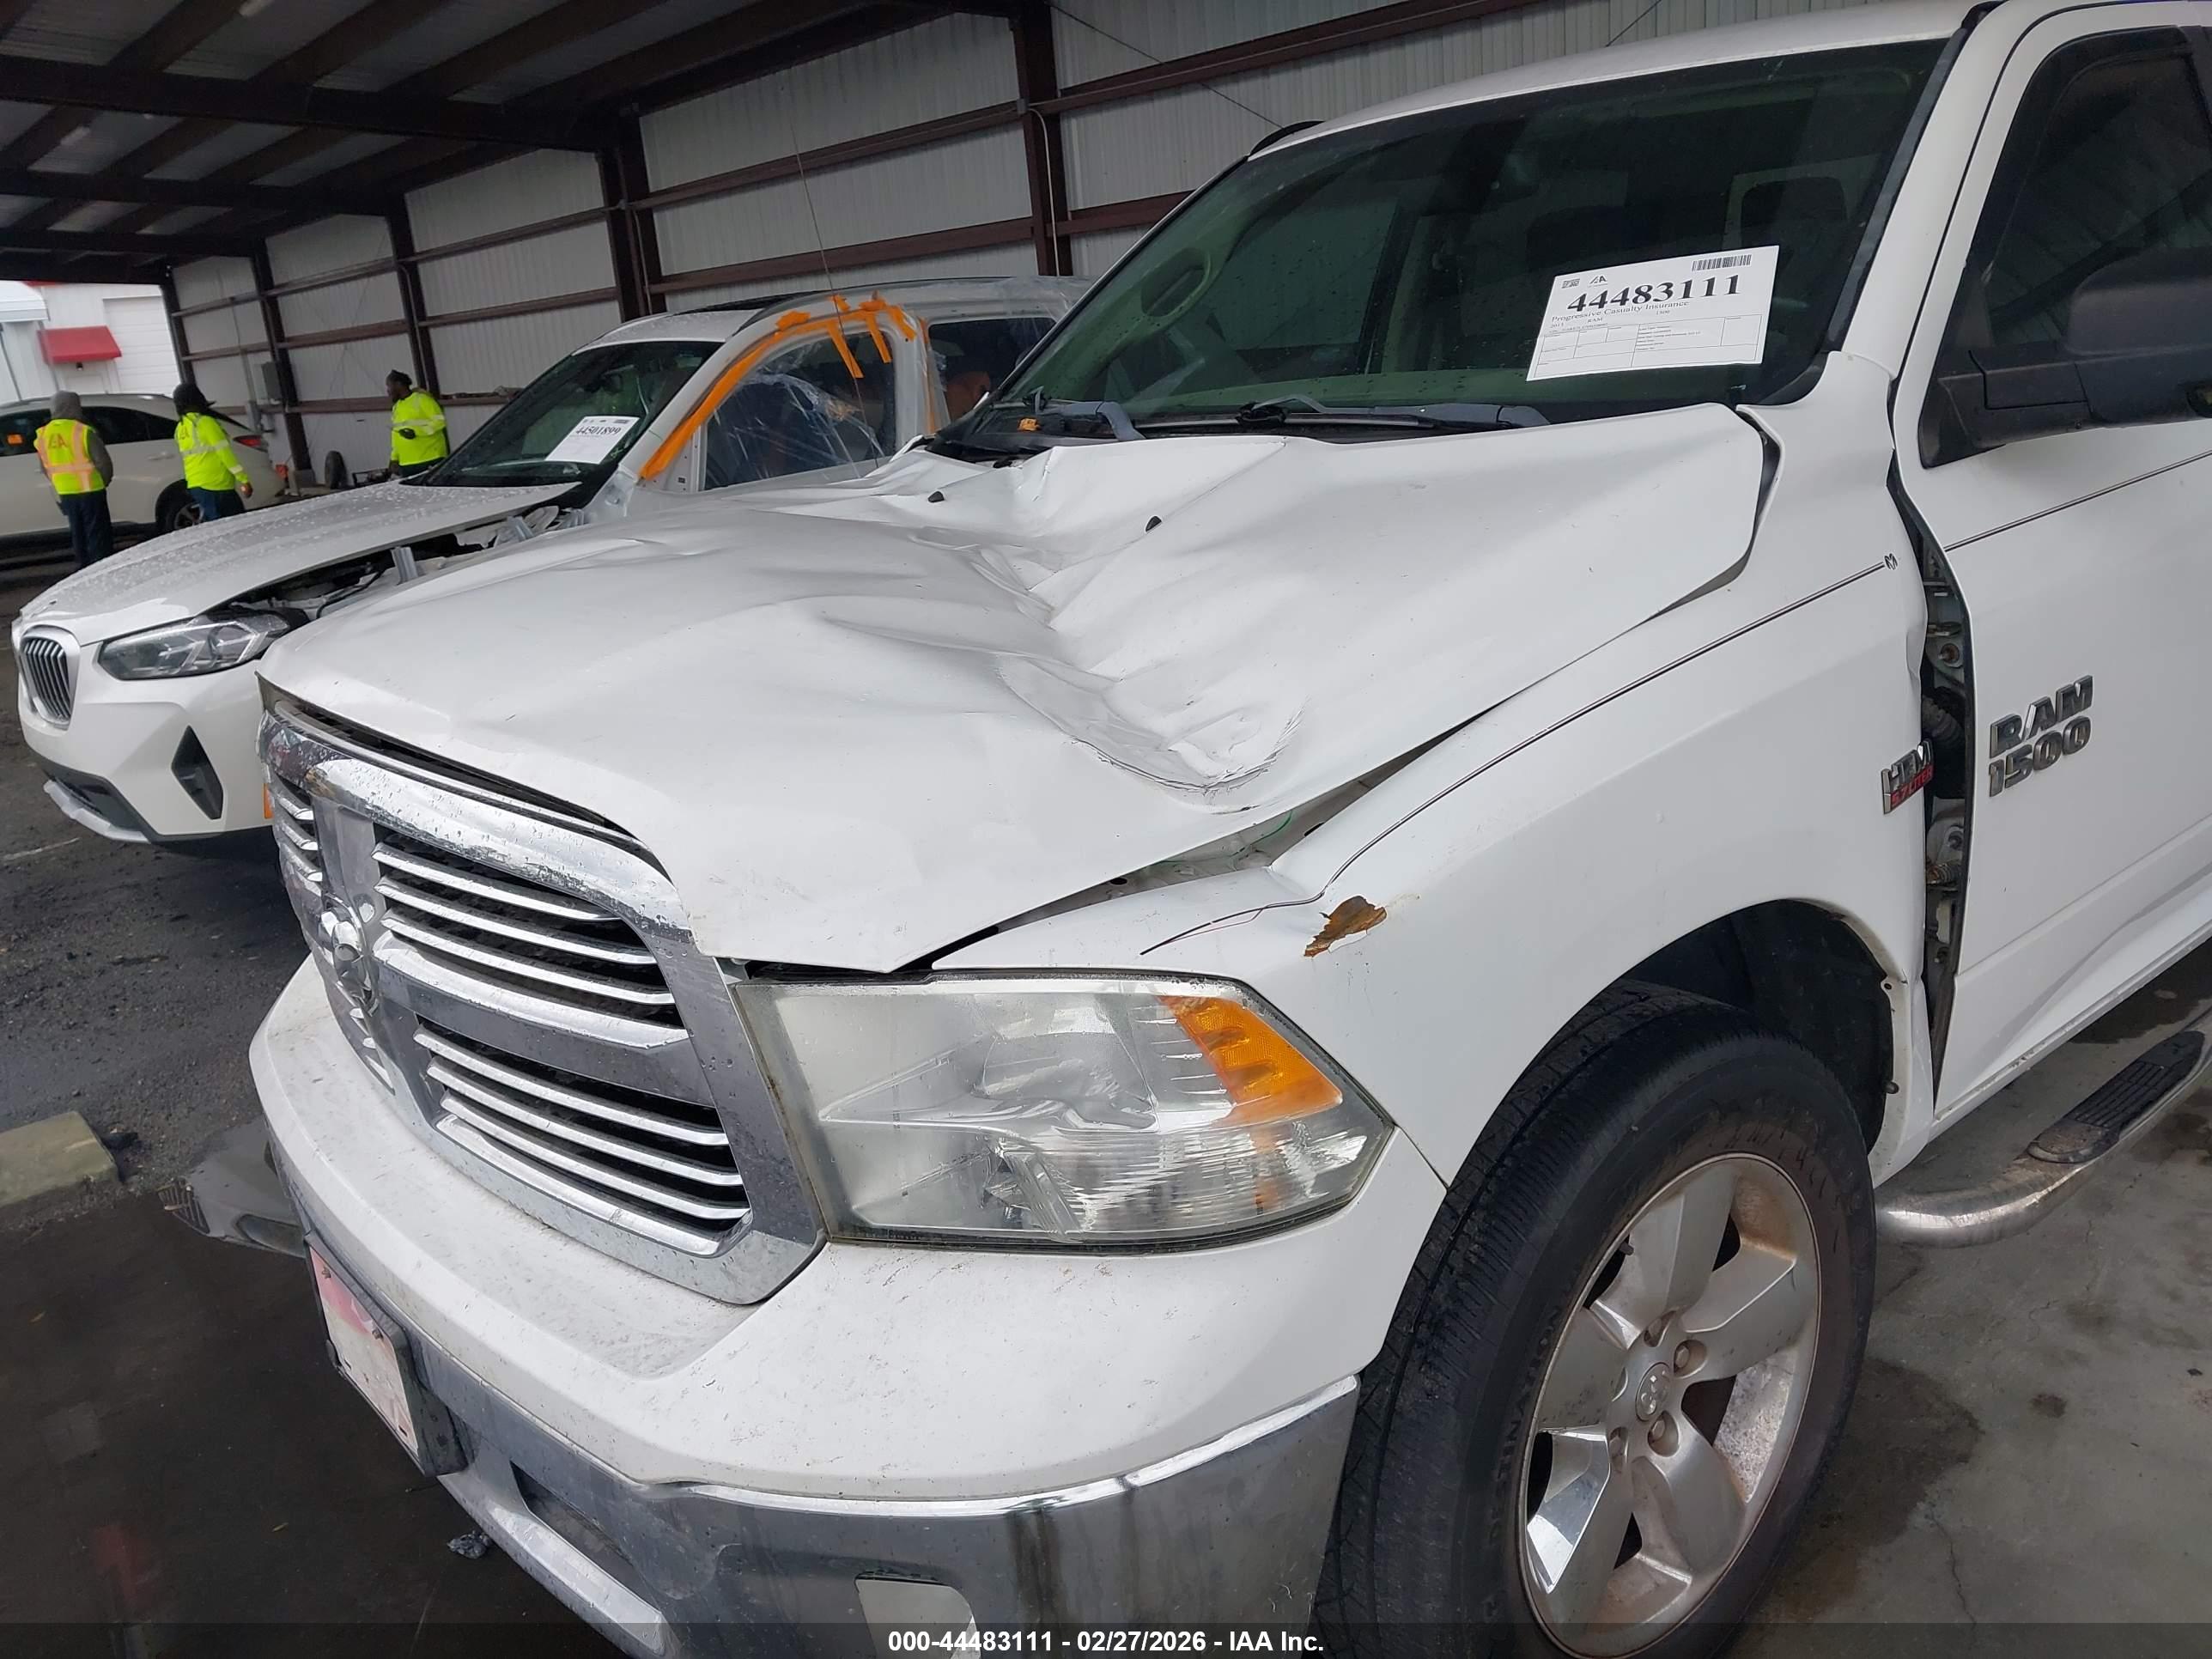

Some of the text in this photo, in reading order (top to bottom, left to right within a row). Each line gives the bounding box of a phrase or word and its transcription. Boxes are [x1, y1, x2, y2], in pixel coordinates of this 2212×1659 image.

[1552, 301, 1690, 324] Progressive Casualty Insurance
[1567, 274, 1740, 313] 44483111
[576, 426, 622, 434] 44501899
[1989, 675, 2094, 759] RAM
[1988, 715, 2093, 798] 1500
